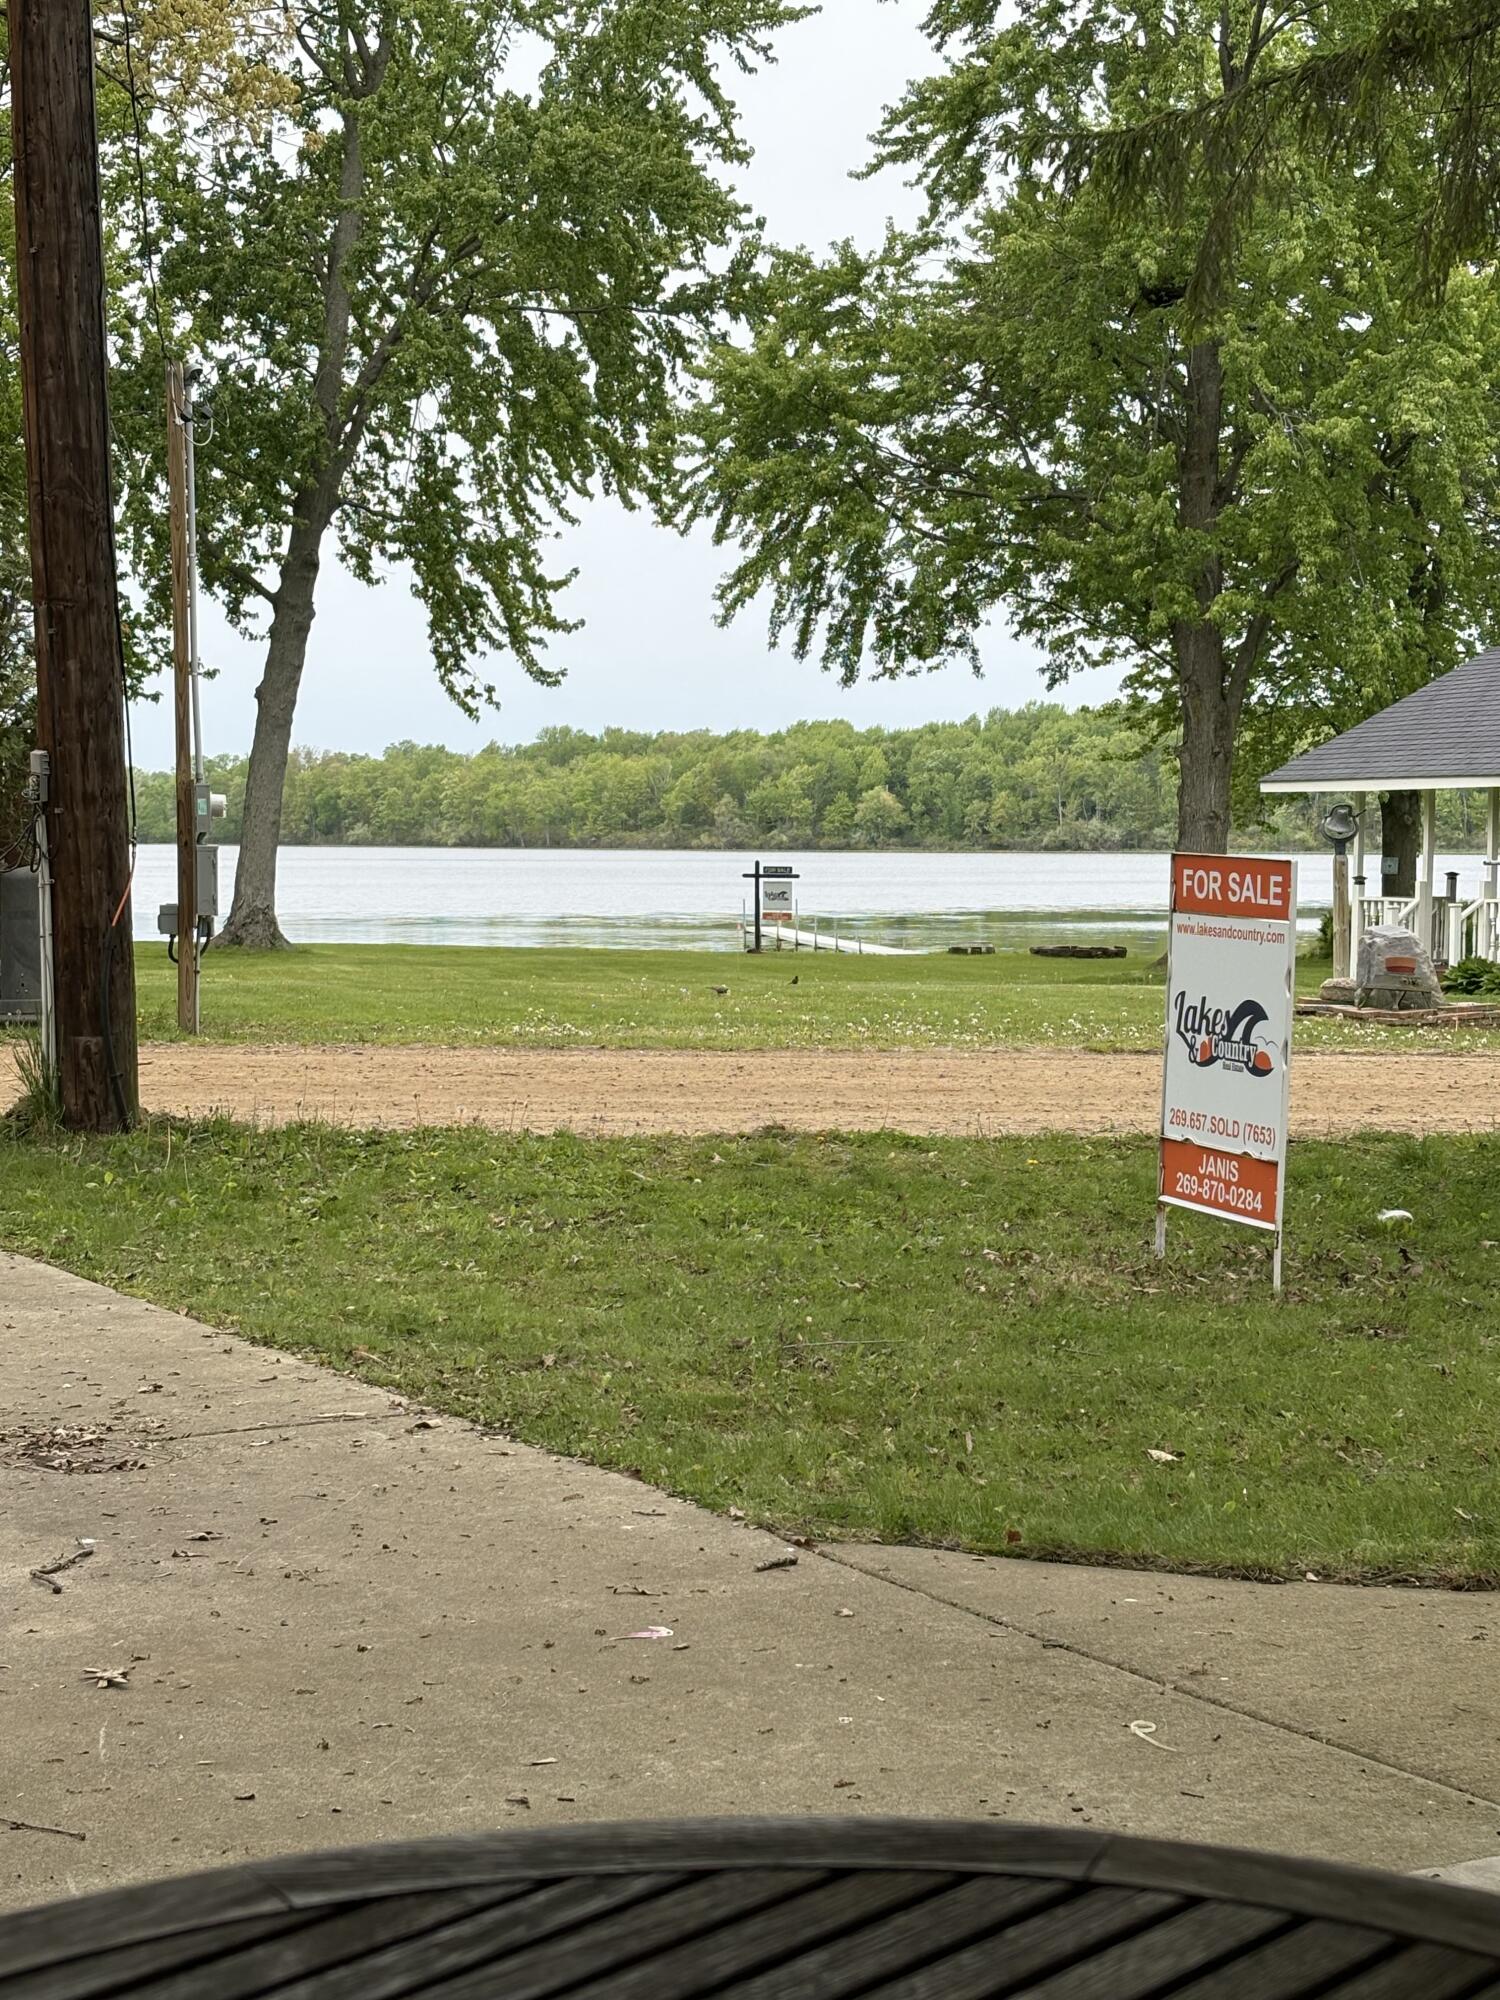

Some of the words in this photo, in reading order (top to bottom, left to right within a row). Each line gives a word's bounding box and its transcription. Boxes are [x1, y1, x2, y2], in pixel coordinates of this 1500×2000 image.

[1182, 868, 1223, 901] FOR
[1227, 871, 1283, 906] SALE
[1176, 921, 1285, 945] www.lakesandcountry.com
[1174, 990, 1231, 1037] Lakes
[1188, 1035, 1199, 1064] &
[1211, 1034, 1258, 1068] Country
[1169, 1107, 1240, 1138] 269.657.SOLD
[1243, 1122, 1276, 1152] (7653)
[1198, 1153, 1239, 1183] JANIS
[1175, 1171, 1263, 1213] 269-870-0284
